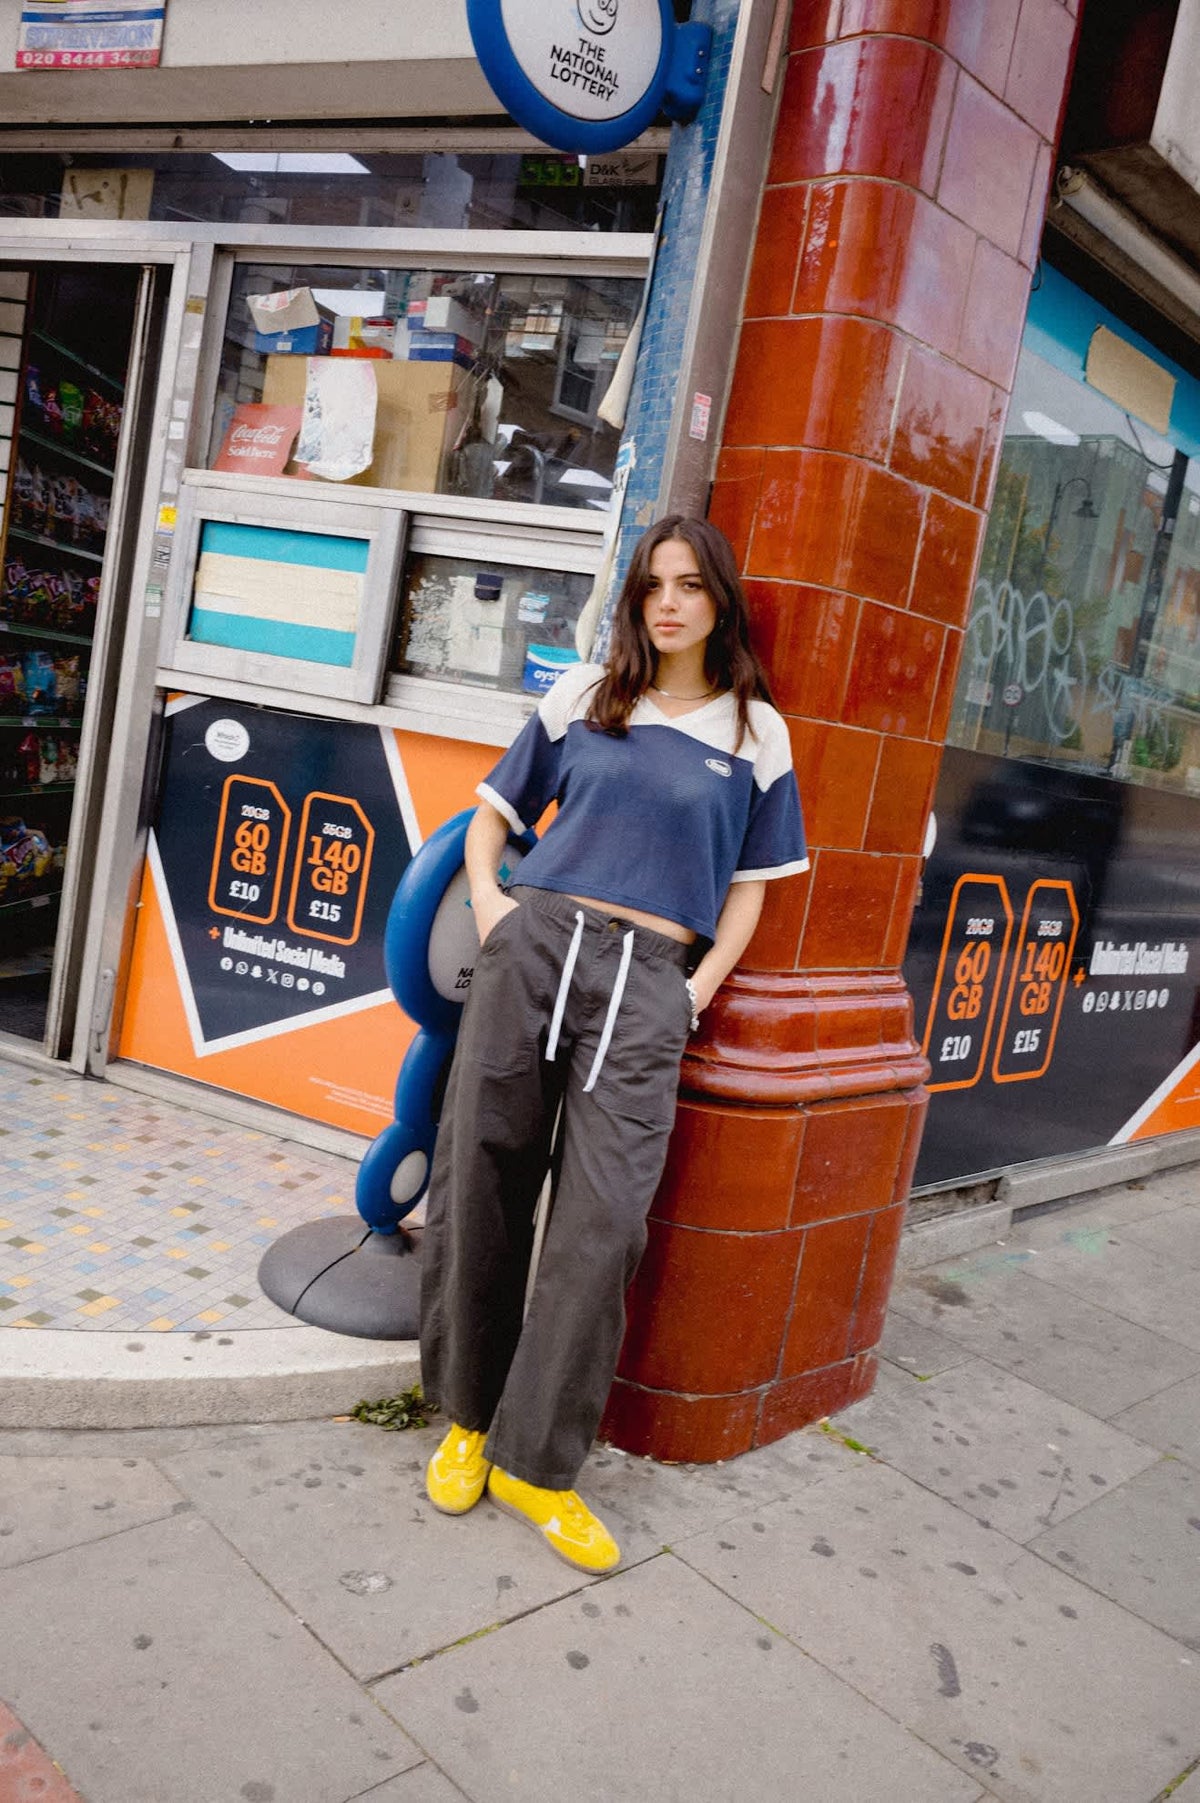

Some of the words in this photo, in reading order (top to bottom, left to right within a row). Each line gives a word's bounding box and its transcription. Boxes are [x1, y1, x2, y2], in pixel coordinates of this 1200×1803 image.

[22, 52, 55, 64] 020
[61, 52, 105, 65] 8444
[579, 38, 606, 62] THE
[550, 45, 619, 88] NATIONAL
[550, 63, 615, 101] LOTTERY
[590, 163, 620, 176] D&K
[534, 669, 559, 682] oyst
[234, 820, 271, 852] 60
[230, 847, 268, 876] GB
[307, 835, 362, 874] 140
[229, 880, 260, 902] £10
[311, 866, 349, 896] GB
[308, 900, 342, 922] £15
[223, 926, 277, 960] Unlimited
[275, 940, 313, 969] Social
[310, 949, 346, 979] Media
[954, 941, 992, 985] 60
[1019, 941, 1067, 982] 140
[1089, 941, 1140, 976] Unlimited
[1134, 942, 1167, 975] Social
[1160, 942, 1189, 974] Media
[454, 979, 471, 989] LO
[457, 967, 474, 978] NA
[946, 983, 984, 1021] GB
[1019, 981, 1053, 1016] GB
[939, 1034, 972, 1062] £10
[1012, 1029, 1042, 1054] £15
